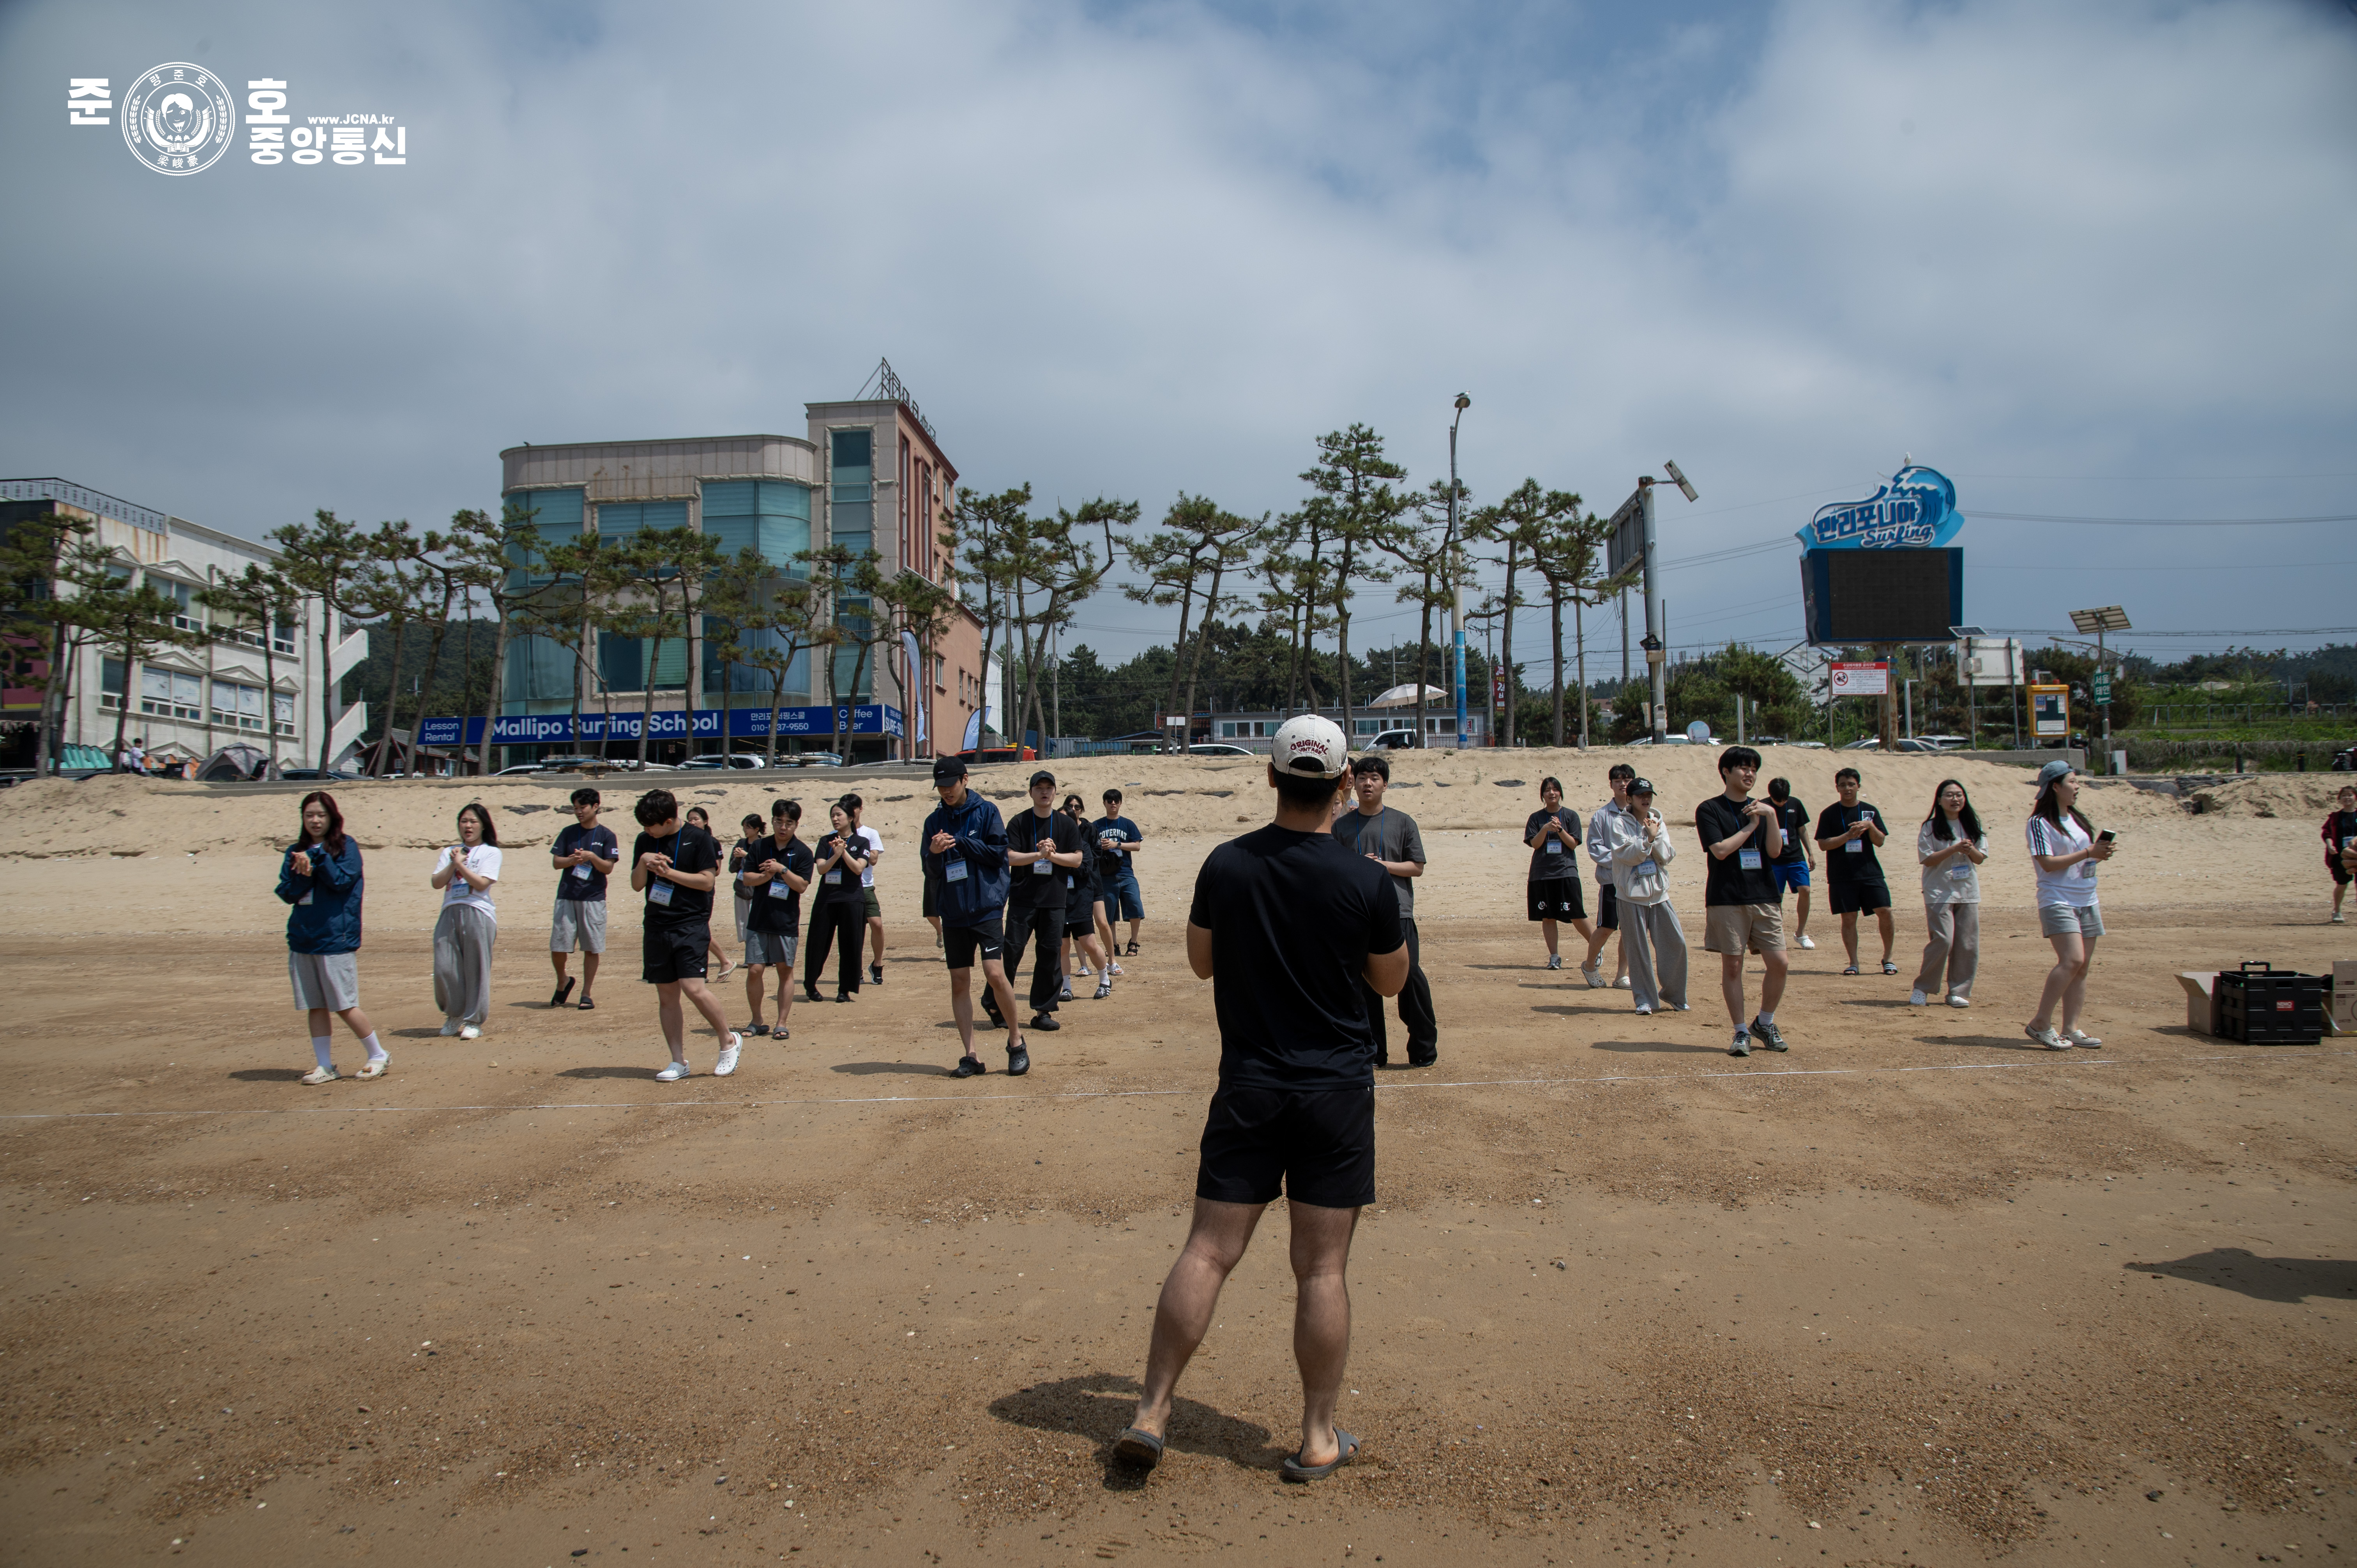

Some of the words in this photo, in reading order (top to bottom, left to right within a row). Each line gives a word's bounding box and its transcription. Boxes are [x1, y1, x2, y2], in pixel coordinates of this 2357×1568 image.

[1817, 501, 1918, 542] 만리포니아
[1863, 524, 1932, 546] Surfing
[2095, 675, 2108, 684] 서울
[2096, 685, 2110, 695] 태안
[839, 709, 873, 718] Cffee
[492, 718, 563, 739] Mallipo
[839, 721, 863, 730] Ber
[425, 733, 455, 741] Rental
[1290, 740, 1328, 755] ORIGINAL
[1099, 828, 1127, 840] COVERNAT
